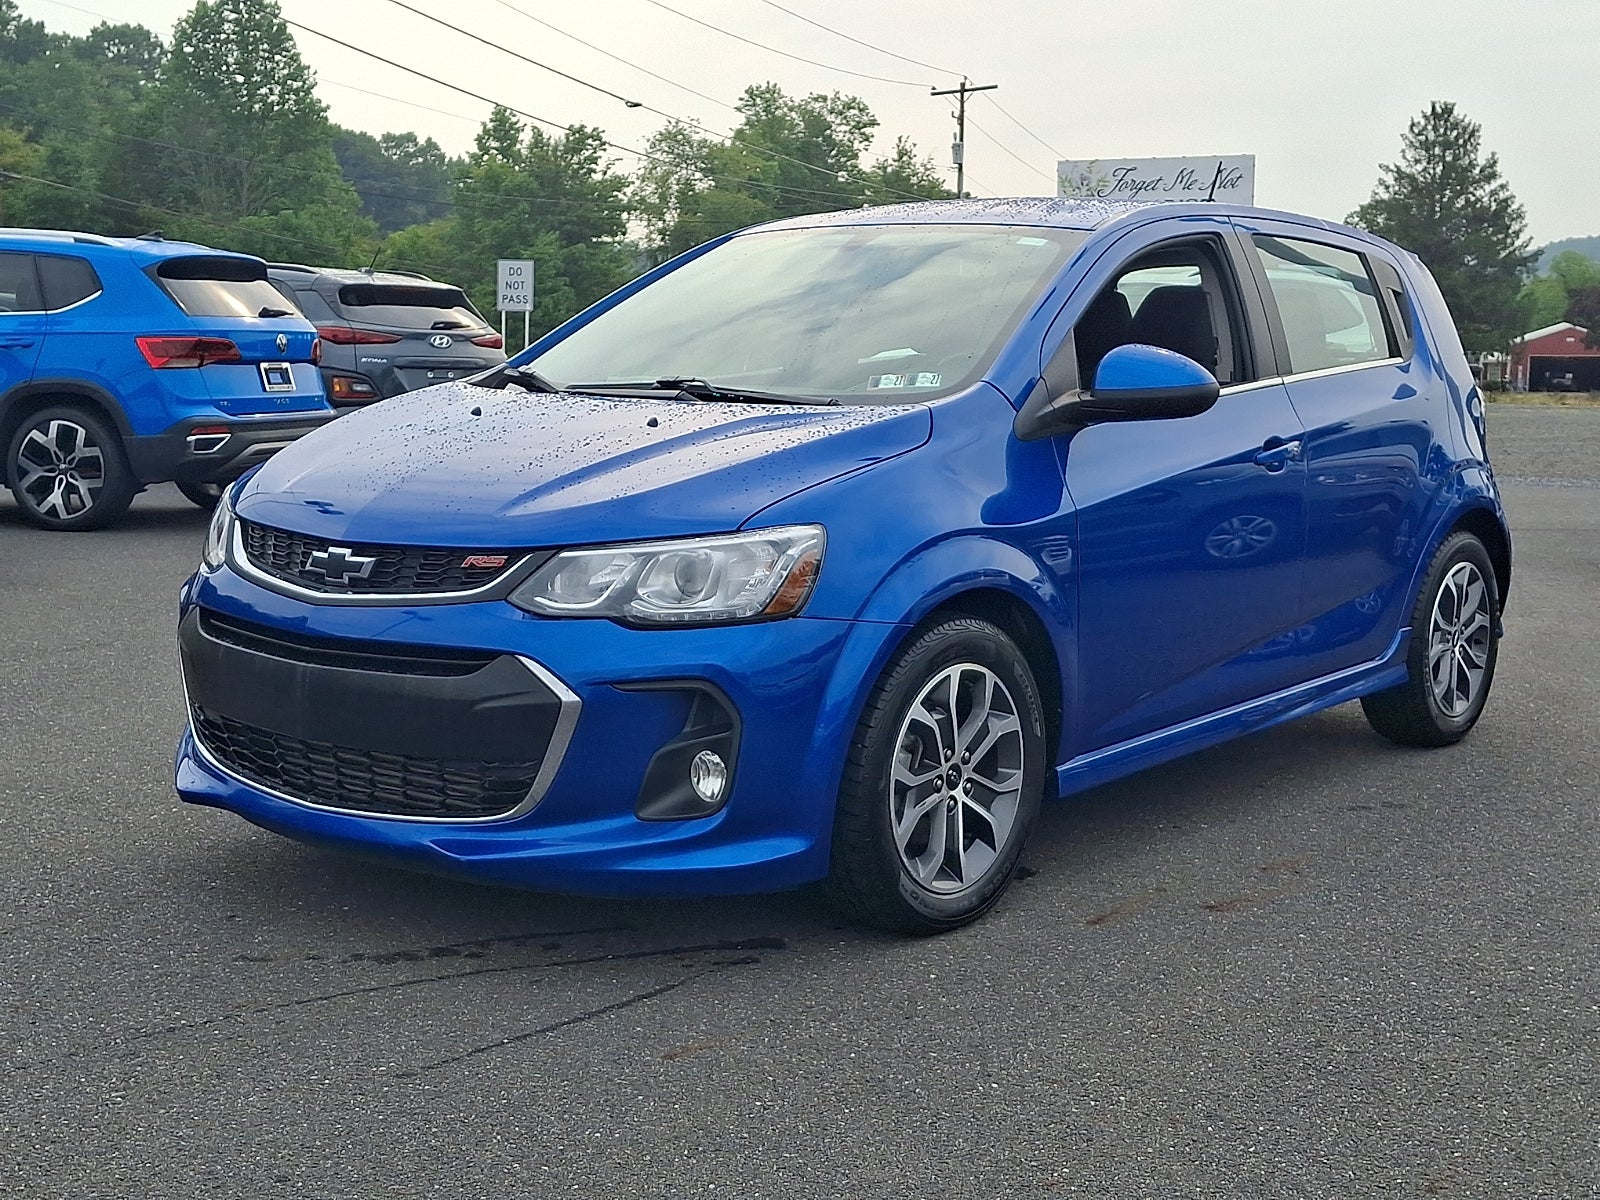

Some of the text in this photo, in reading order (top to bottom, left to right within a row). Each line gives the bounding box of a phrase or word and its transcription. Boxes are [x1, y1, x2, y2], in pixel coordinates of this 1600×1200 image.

[1097, 166, 1244, 199] Forget Me Not
[508, 266, 523, 276] DO
[505, 280, 526, 290] NOT
[502, 294, 529, 304] PASS
[460, 555, 509, 568] RS
